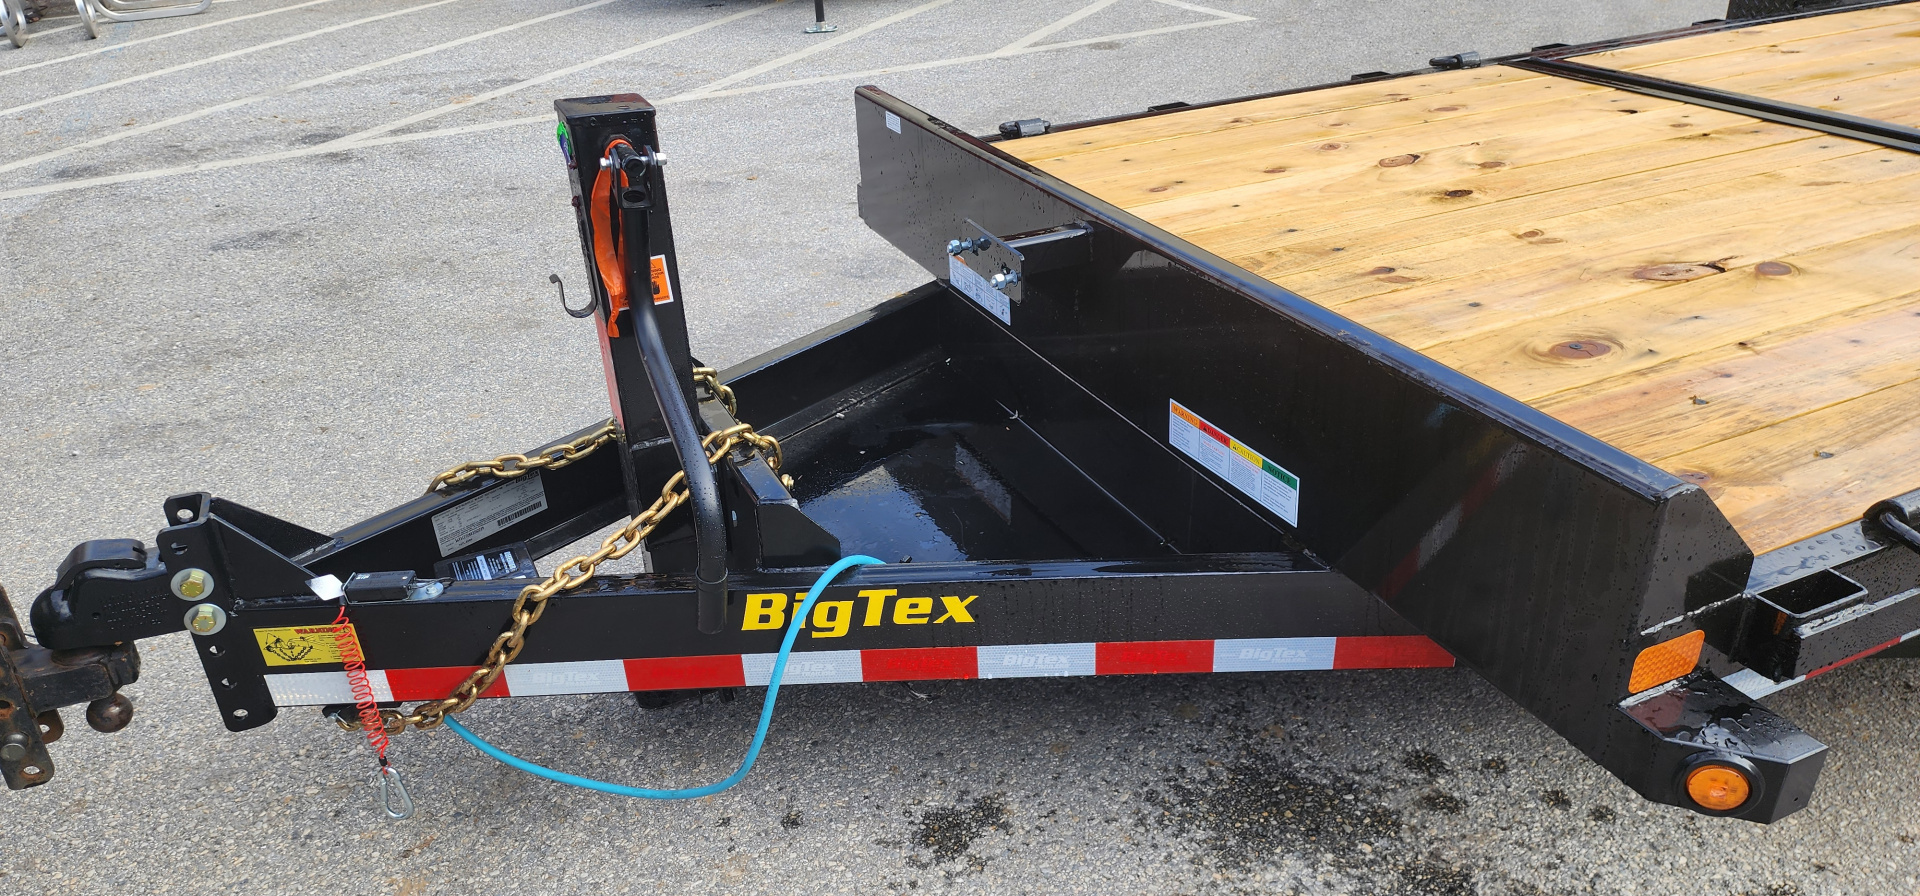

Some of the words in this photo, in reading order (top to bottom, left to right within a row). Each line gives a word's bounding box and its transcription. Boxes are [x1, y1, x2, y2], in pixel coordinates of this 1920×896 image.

[1173, 405, 1199, 426] WARNING
[1208, 428, 1229, 444] DANGER
[1236, 447, 1261, 465] CAUTION
[1267, 464, 1292, 485] NOTICE
[741, 589, 979, 638] BigTex
[1003, 654, 1070, 667] BigTex
[1240, 648, 1307, 663] BigTex
